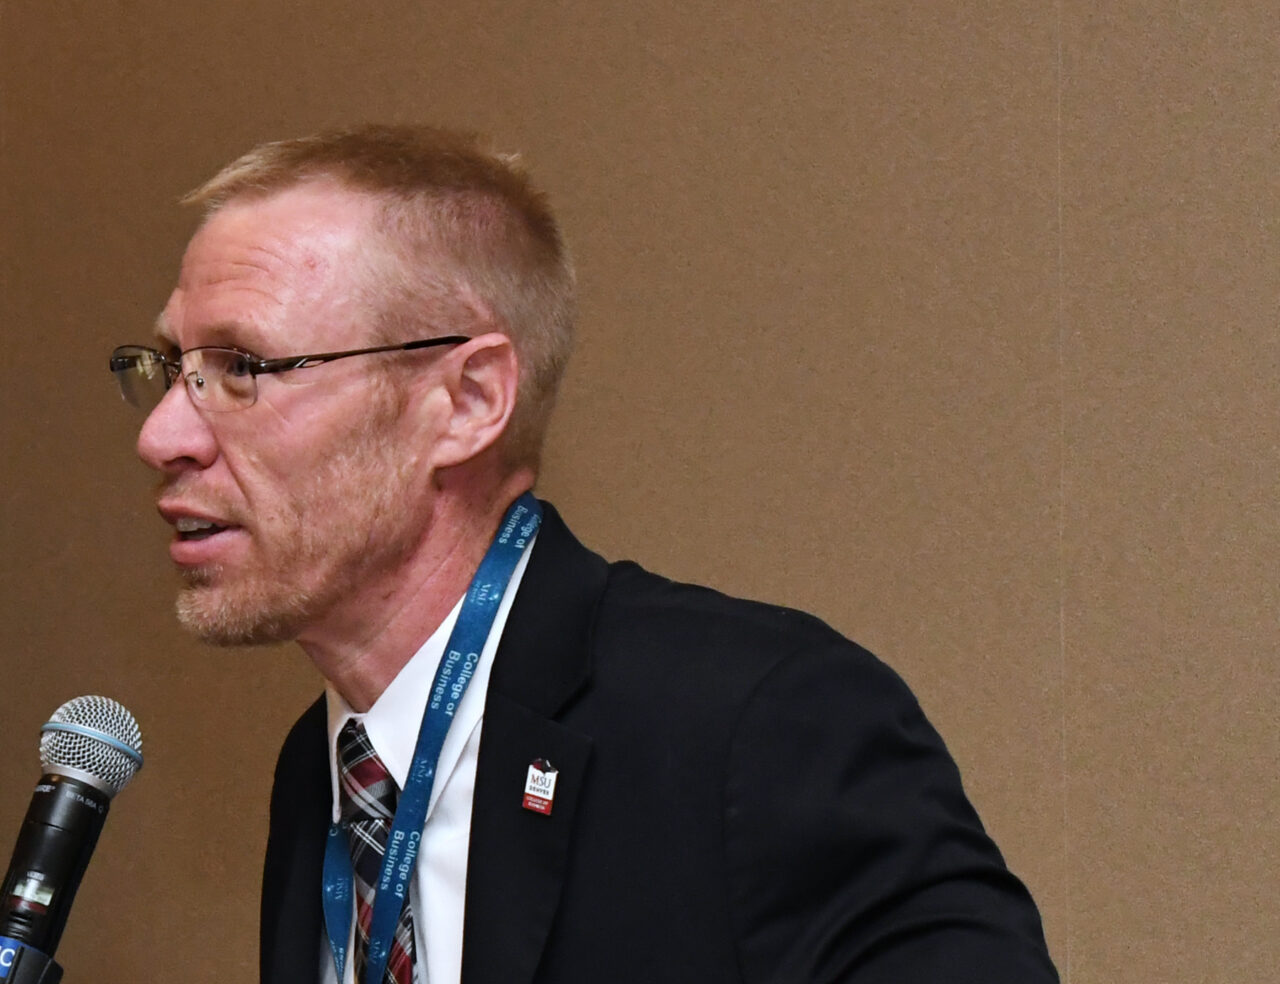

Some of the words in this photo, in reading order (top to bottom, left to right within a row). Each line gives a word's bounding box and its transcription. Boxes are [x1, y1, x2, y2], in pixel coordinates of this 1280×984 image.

[431, 650, 461, 710] Business
[451, 652, 479, 700] College
[445, 702, 455, 717] of
[531, 774, 552, 789] MSU
[380, 830, 405, 891] Business
[398, 831, 420, 881] College
[394, 884, 404, 899] of
